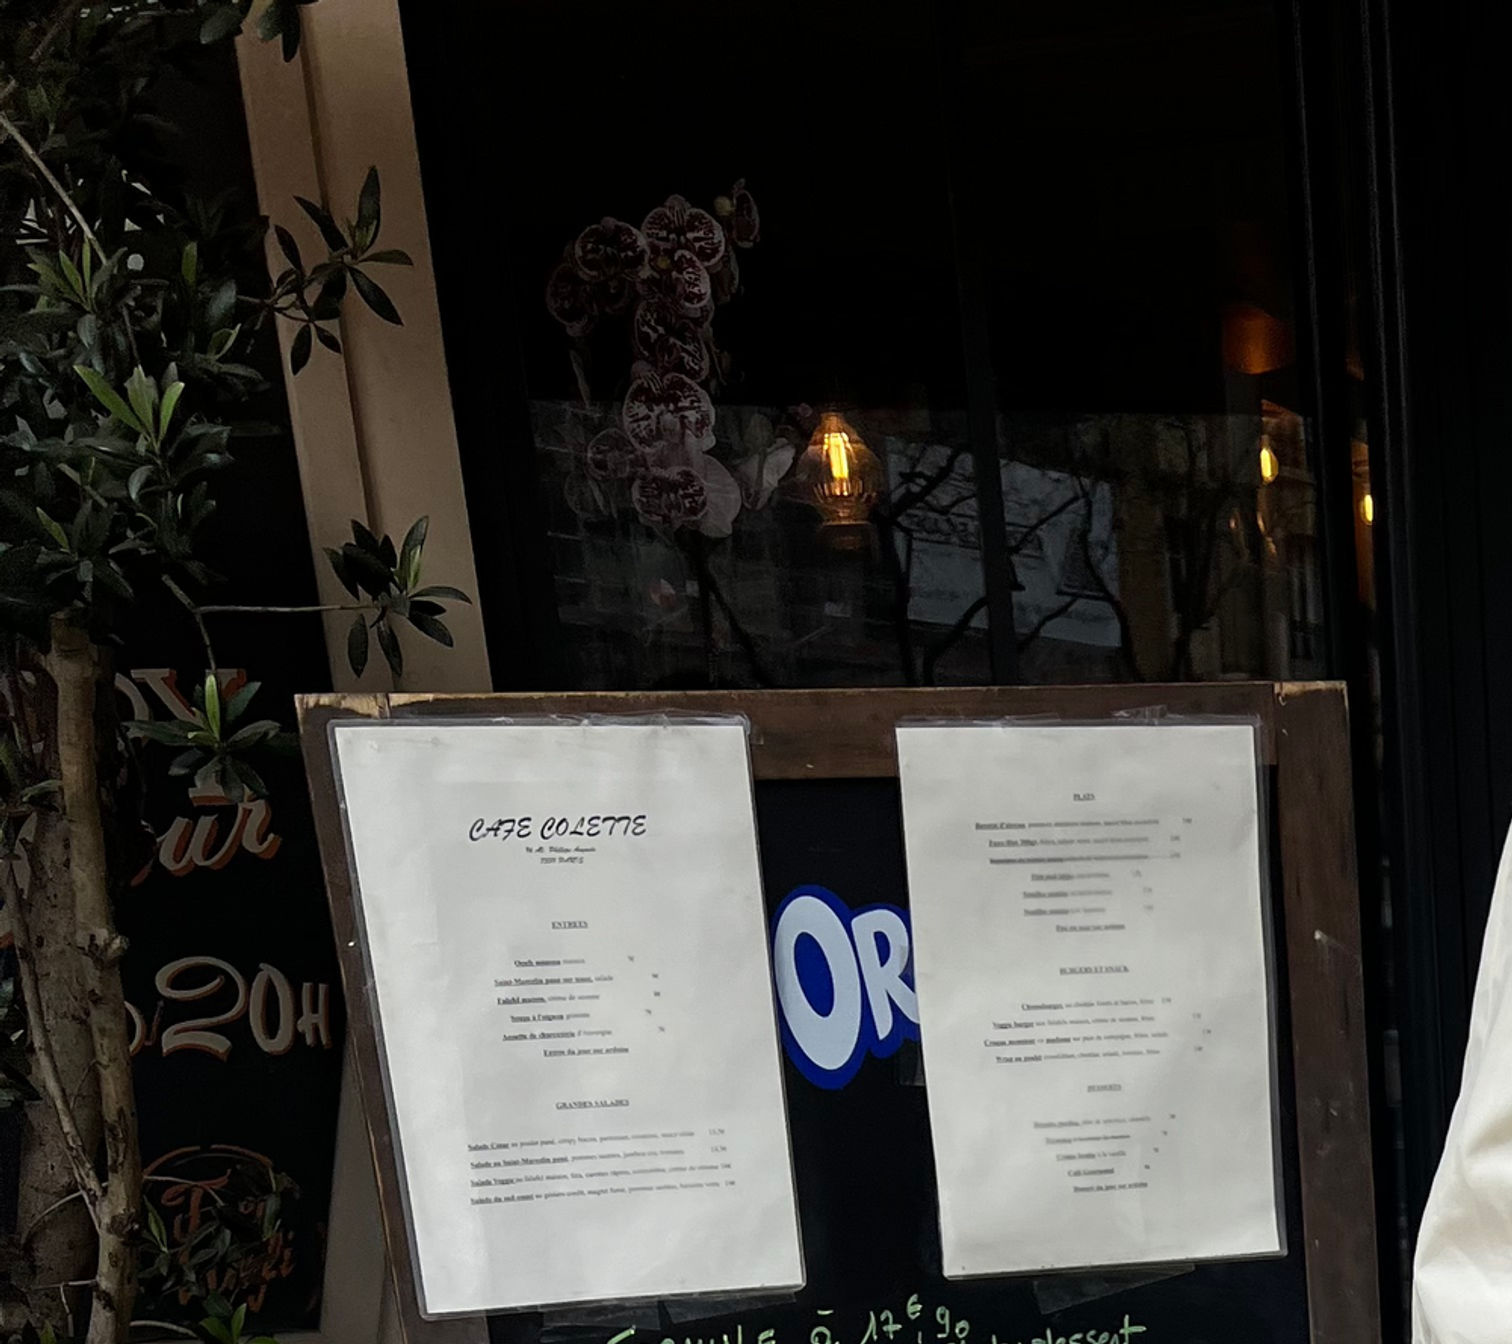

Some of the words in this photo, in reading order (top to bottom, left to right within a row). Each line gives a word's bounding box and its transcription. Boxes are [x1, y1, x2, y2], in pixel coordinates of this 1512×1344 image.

[469, 817, 532, 842] CAFE
[540, 815, 648, 840] COLETTE
[154, 955, 333, 1063] 20H
